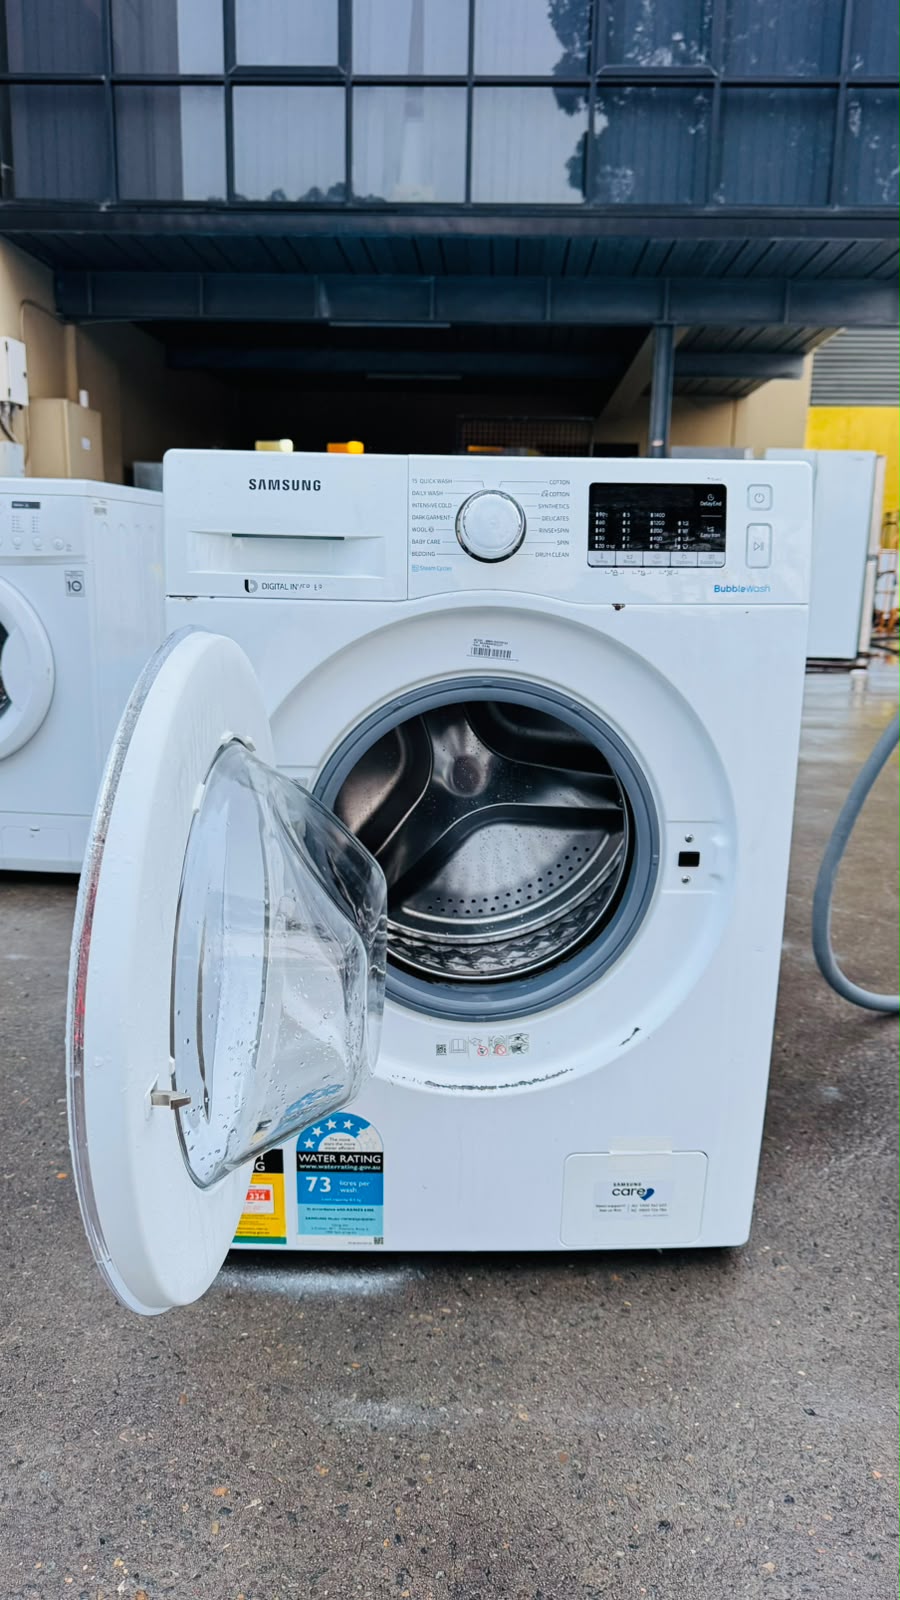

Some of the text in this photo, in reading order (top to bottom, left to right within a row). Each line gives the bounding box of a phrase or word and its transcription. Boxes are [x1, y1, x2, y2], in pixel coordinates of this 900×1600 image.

[248, 478, 322, 492] SAMSUNG
[262, 582, 288, 590] DIGITAL
[298, 1154, 381, 1163] WATER RATING
[305, 1176, 331, 1192] 73
[612, 1188, 646, 1196] care
